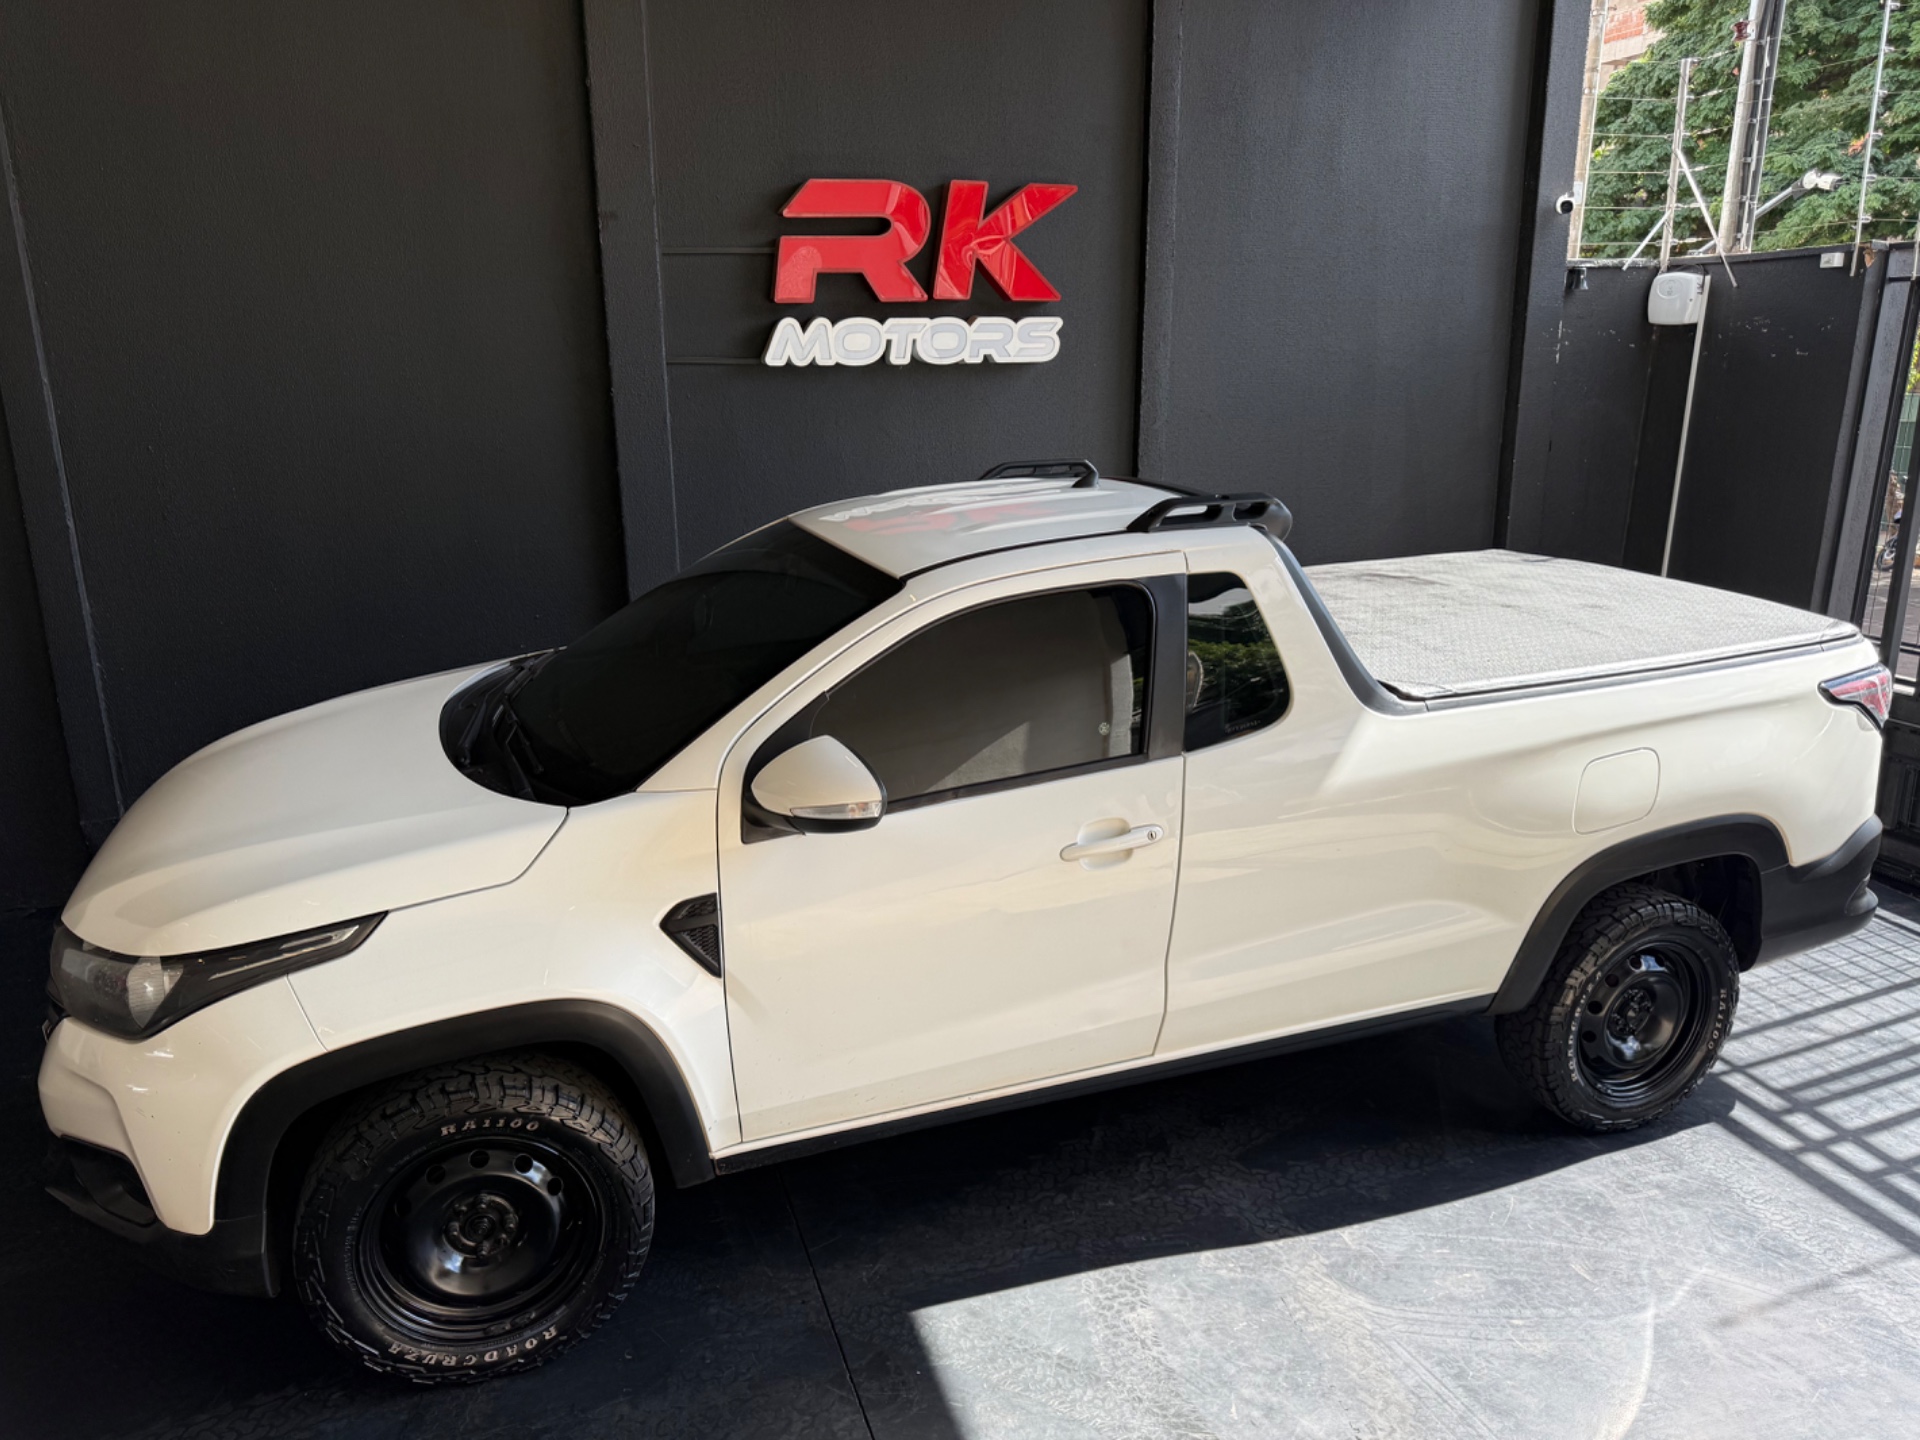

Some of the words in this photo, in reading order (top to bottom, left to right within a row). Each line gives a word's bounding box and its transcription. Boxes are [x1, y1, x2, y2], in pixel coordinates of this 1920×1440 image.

[774, 178, 1079, 303] RK
[764, 316, 1064, 366] MOTORS
[387, 1325, 558, 1367] ROADCRUZA
